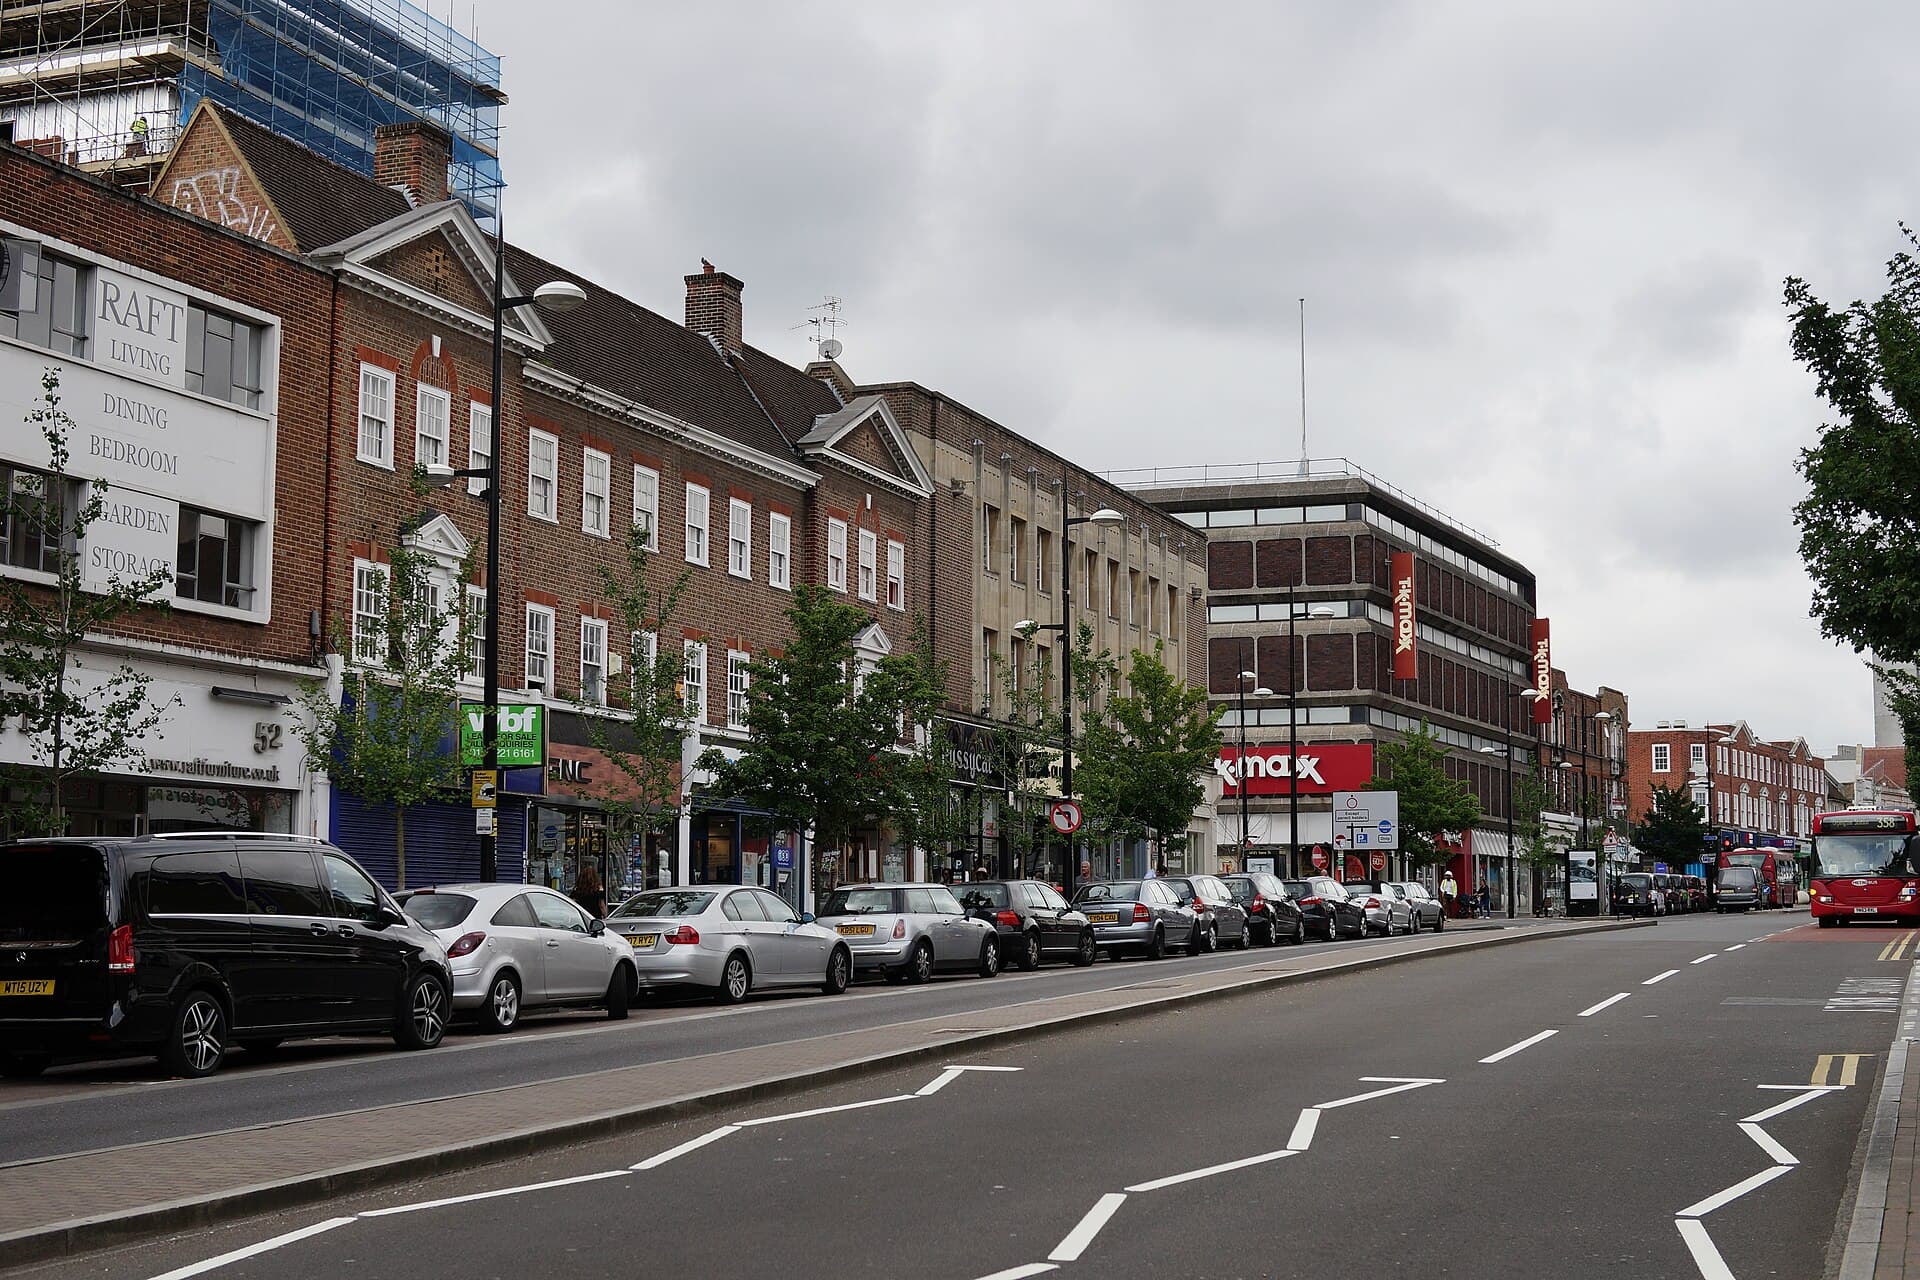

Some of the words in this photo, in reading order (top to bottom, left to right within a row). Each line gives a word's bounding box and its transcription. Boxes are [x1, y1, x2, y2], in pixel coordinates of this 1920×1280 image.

[98, 279, 184, 344] RAFT
[111, 339, 171, 375] LIVING
[103, 392, 168, 430] DINING
[89, 434, 179, 476] BEDROOM
[98, 499, 171, 535] GARDEN
[253, 721, 283, 754] 52
[497, 733, 514, 741] FOR
[498, 741, 534, 749] QUIRIES
[512, 748, 536, 759] 6161
[943, 745, 993, 780] ussyCat
[1877, 817, 1895, 828] 358
[638, 935, 653, 945] RYZ
[28, 980, 49, 993] UZY
